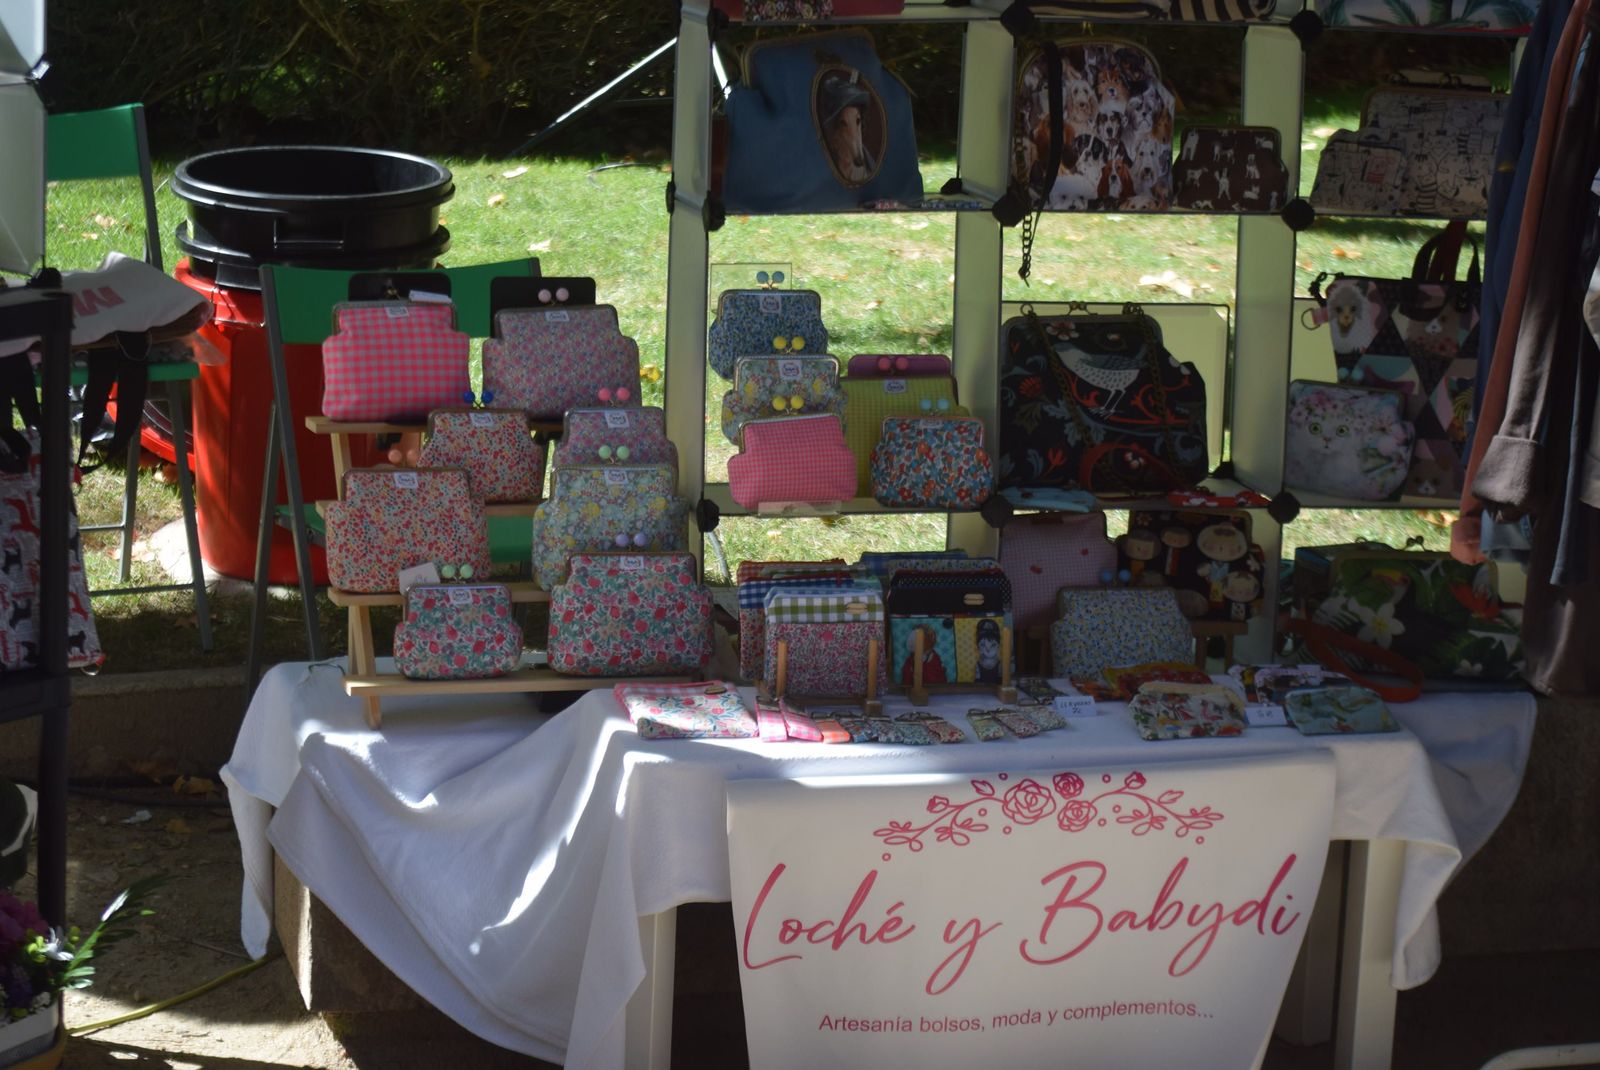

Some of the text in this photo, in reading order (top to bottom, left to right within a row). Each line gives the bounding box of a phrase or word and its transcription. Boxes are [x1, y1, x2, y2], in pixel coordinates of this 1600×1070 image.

[742, 853, 1299, 996] Loché y Babydi
[818, 998, 1214, 1034] Artesanía bolsos, moda y complementos...
